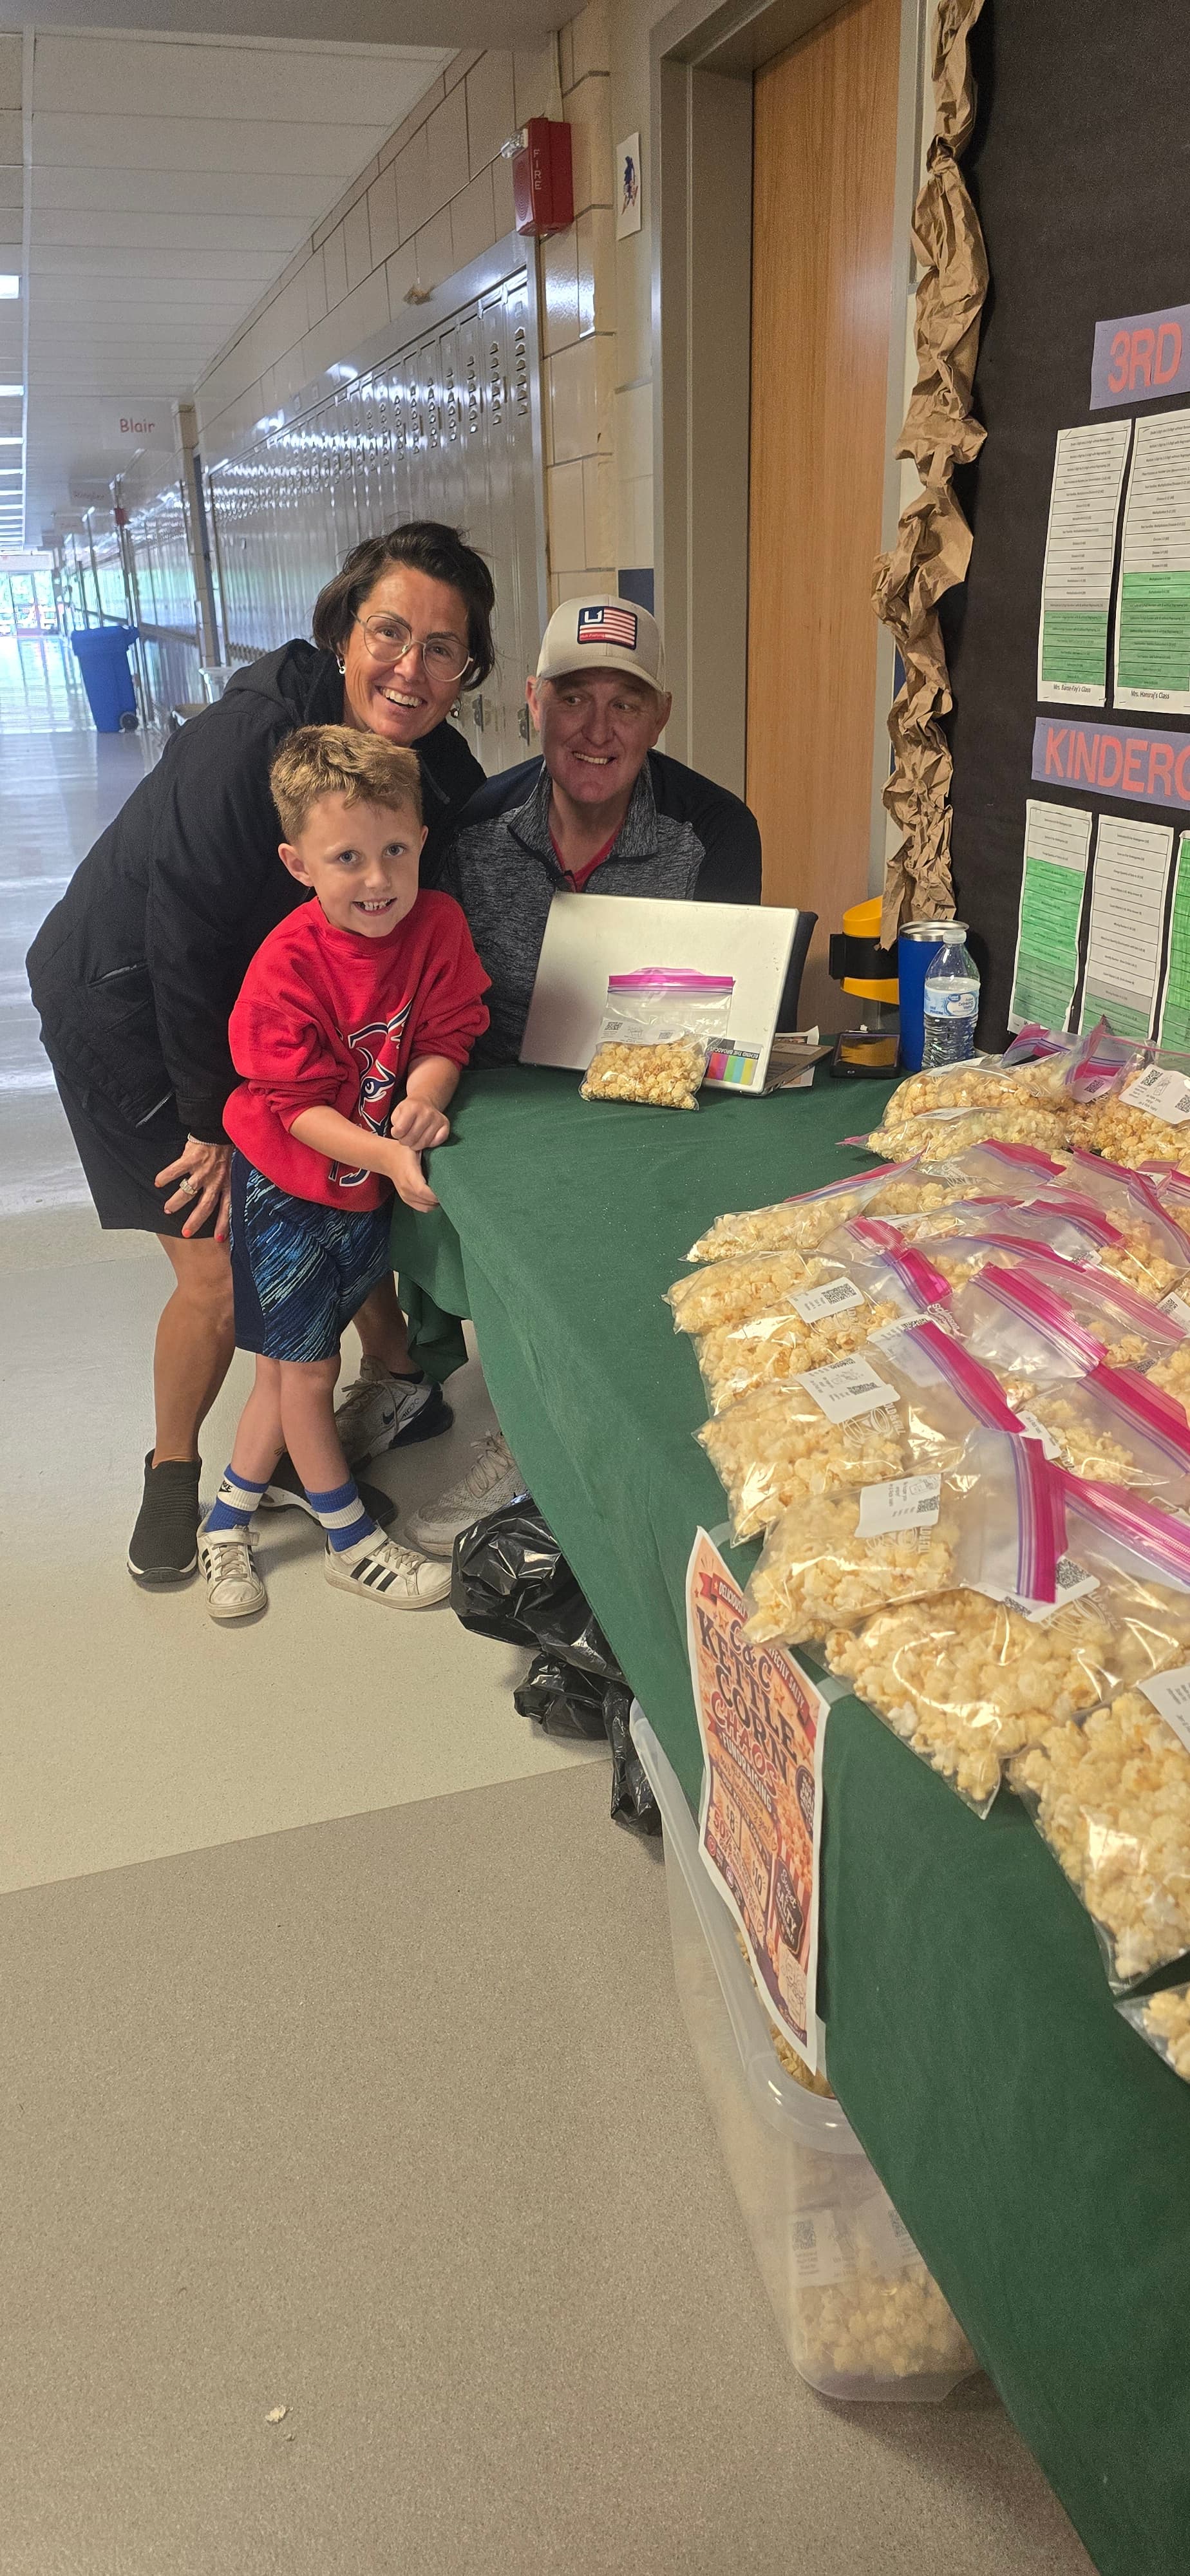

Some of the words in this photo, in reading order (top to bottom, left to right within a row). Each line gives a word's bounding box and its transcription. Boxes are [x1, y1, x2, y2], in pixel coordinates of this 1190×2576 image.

[533, 149, 542, 191] FIRE
[1108, 322, 1182, 393] 3RD
[119, 418, 155, 433] Blair
[719, 1581, 747, 1617] DELICIOUSLY
[696, 1605, 798, 1765] KETTLE
[711, 1692, 778, 1797] CHAOS
[715, 1665, 789, 1784] CORN
[722, 1736, 771, 1813] FUNDRAISING
[713, 1804, 732, 1855] 50%
[726, 1803, 734, 1836] $8
[733, 1789, 750, 1828] KETTLE
[750, 1822, 762, 1854] CORN
[751, 1859, 762, 1897] $10
[777, 1881, 797, 1935] SALTY
